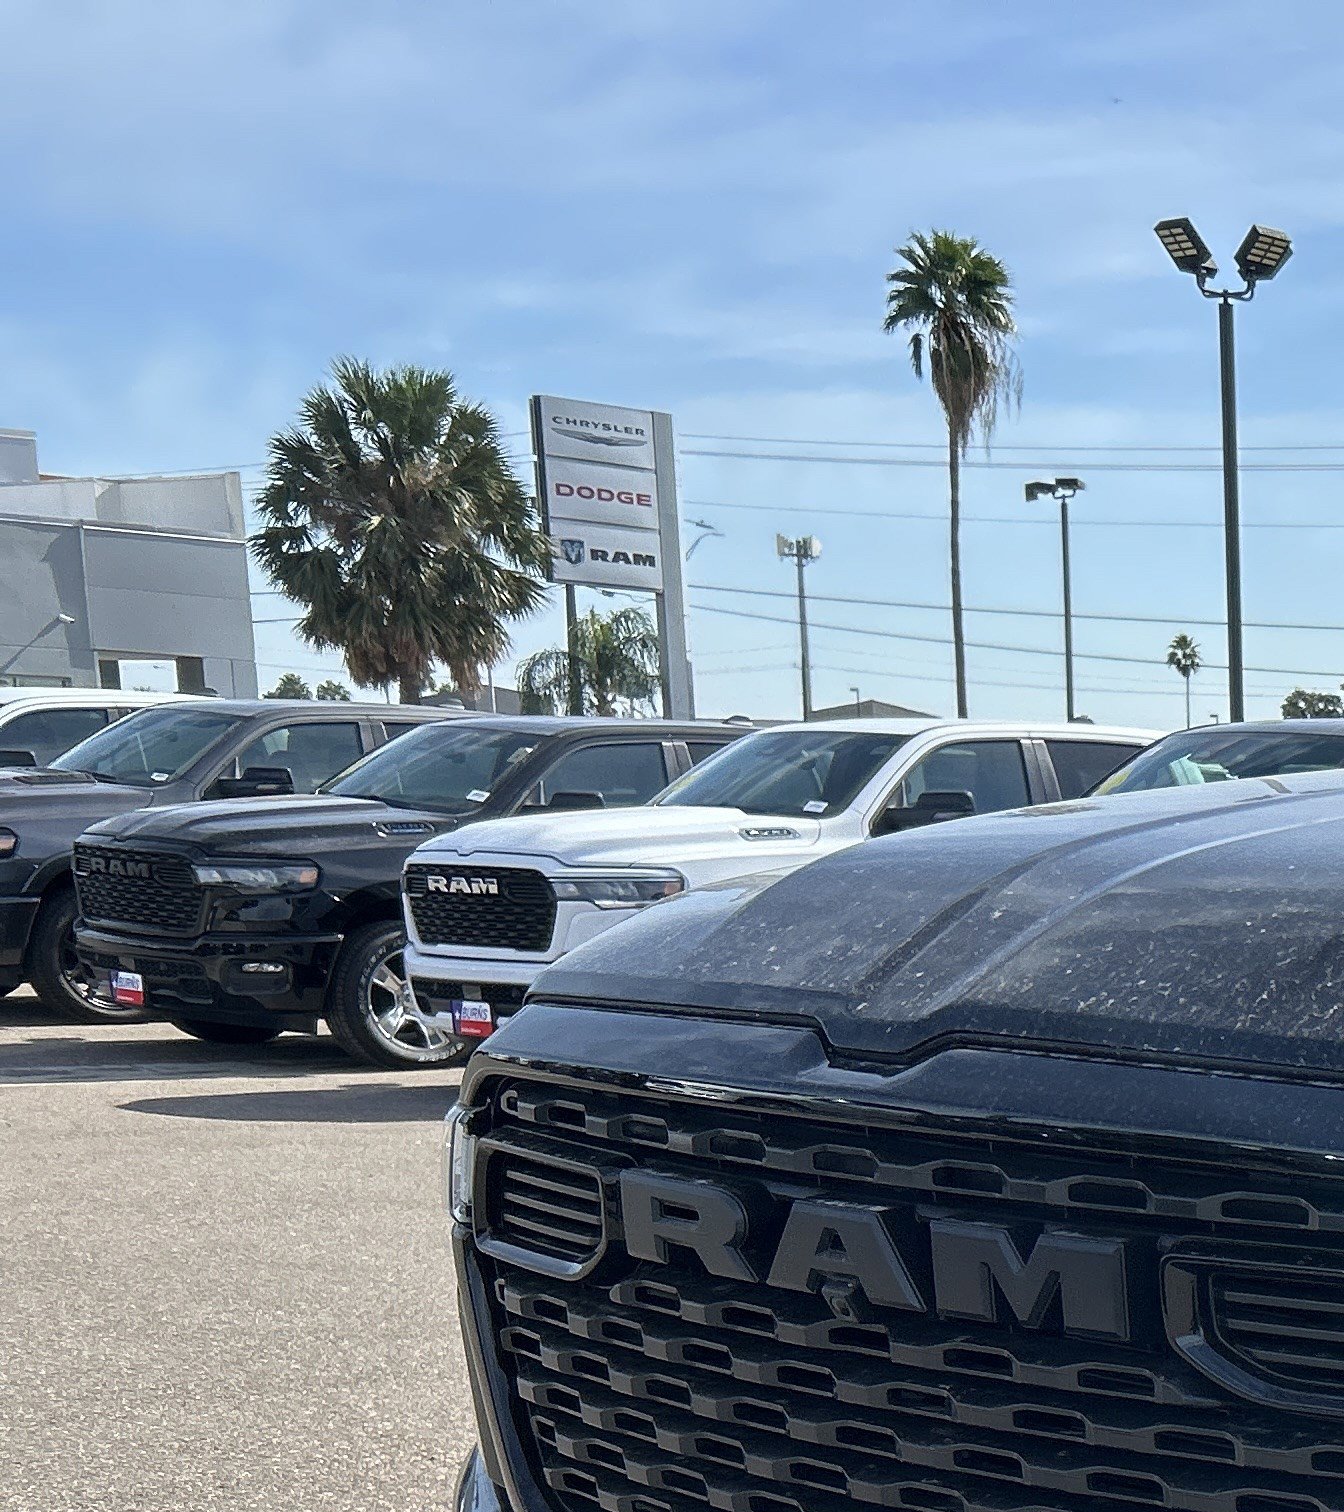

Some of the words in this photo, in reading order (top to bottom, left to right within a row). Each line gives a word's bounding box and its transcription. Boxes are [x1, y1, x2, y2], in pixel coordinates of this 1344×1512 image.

[551, 415, 646, 437] CHRYSLER
[555, 482, 653, 507] DODGE
[589, 548, 656, 568] RAM
[89, 857, 150, 878] RAM
[426, 875, 499, 895] RAM
[618, 1168, 1130, 1343] RAM
